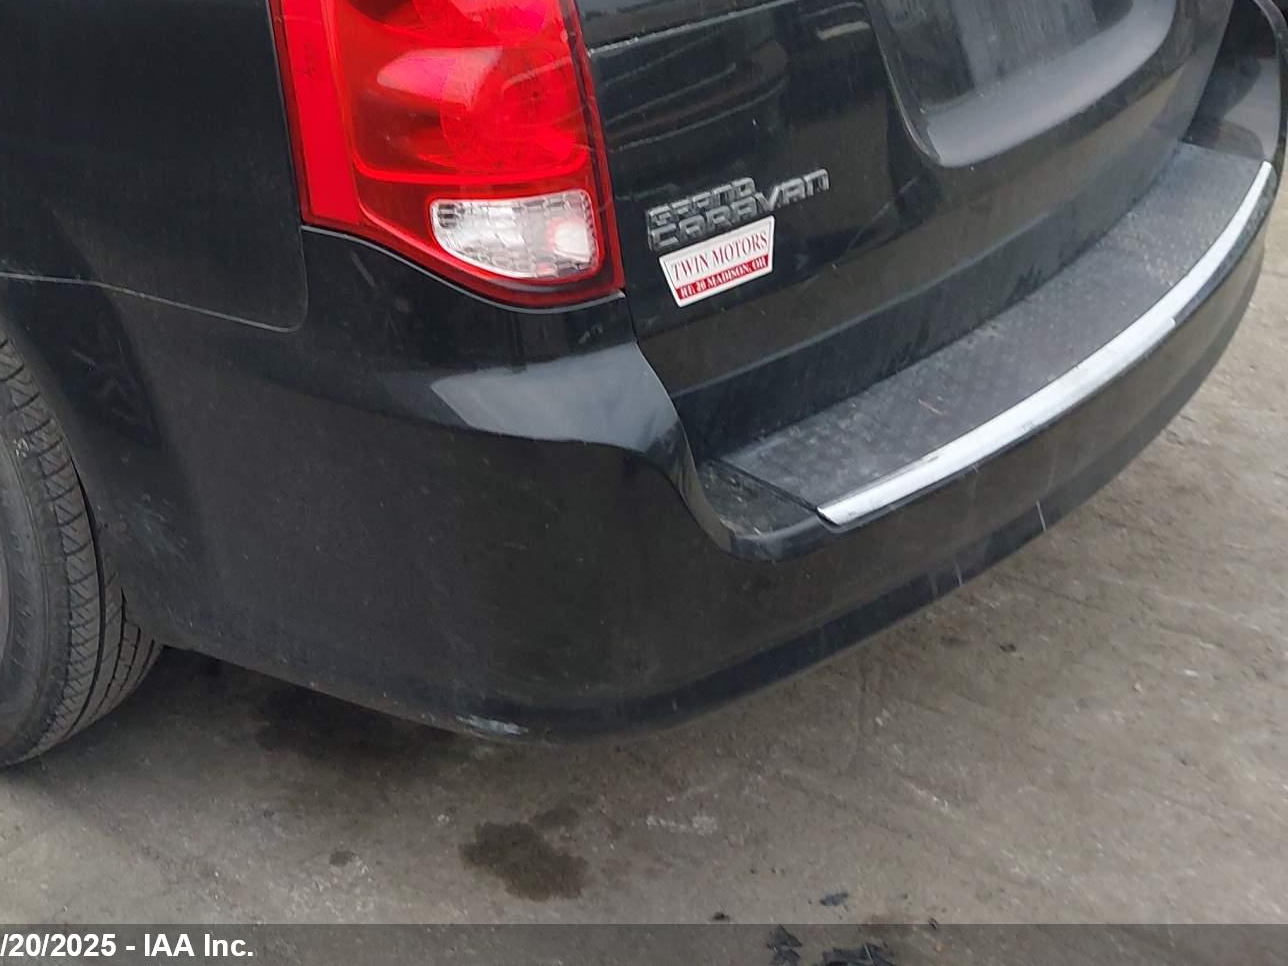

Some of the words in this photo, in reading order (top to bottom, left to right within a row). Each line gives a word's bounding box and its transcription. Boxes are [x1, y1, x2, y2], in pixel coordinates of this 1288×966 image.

[647, 177, 756, 227] GRAND
[649, 169, 829, 251] CARAVAN
[673, 250, 710, 281] TWIN
[712, 230, 768, 266] MOTORS
[752, 256, 767, 272] OH
